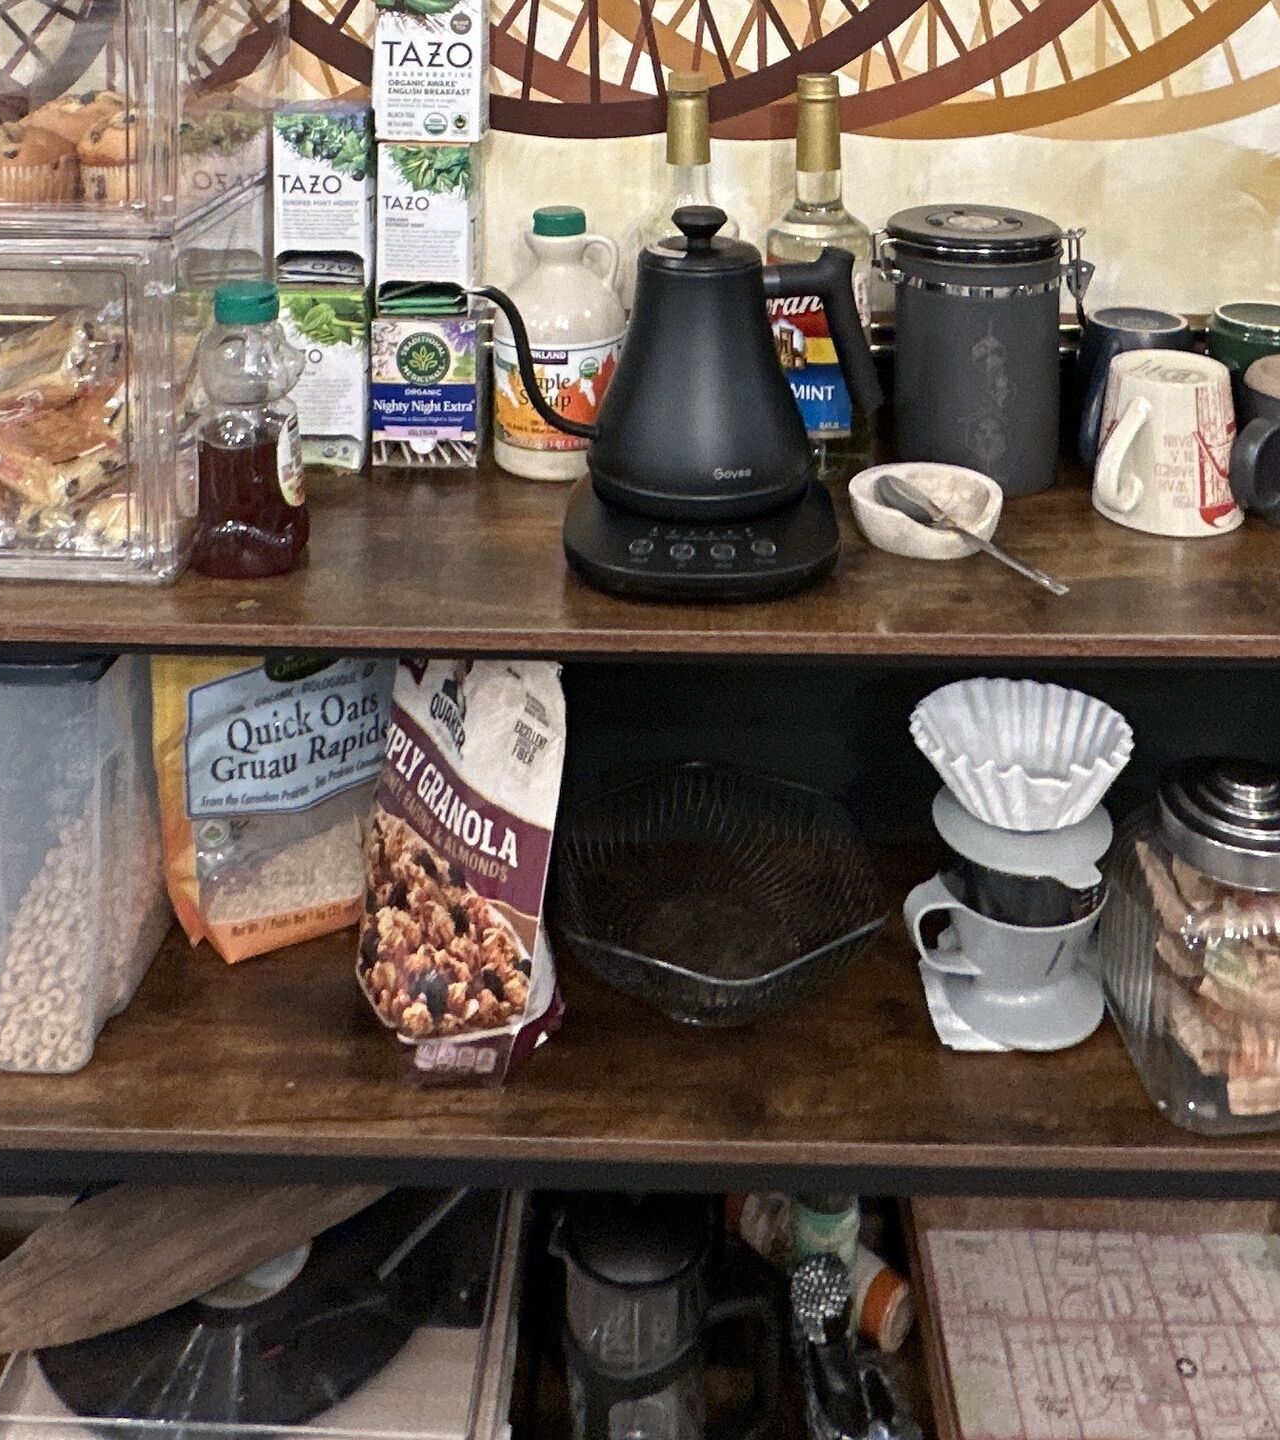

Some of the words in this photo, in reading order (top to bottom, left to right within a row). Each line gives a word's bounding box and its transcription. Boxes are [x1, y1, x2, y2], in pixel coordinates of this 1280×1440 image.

[382, 41, 473, 68] TAZO
[424, 88, 471, 96] BREAKFAST
[278, 175, 342, 194] TAZO
[382, 195, 430, 211] TAZO
[374, 399, 410, 415] Nighty
[411, 400, 441, 415] Night
[226, 699, 314, 754] Quick
[320, 693, 378, 727] Oats
[210, 751, 298, 784] Gruau
[417, 763, 518, 868] GRANOLA
